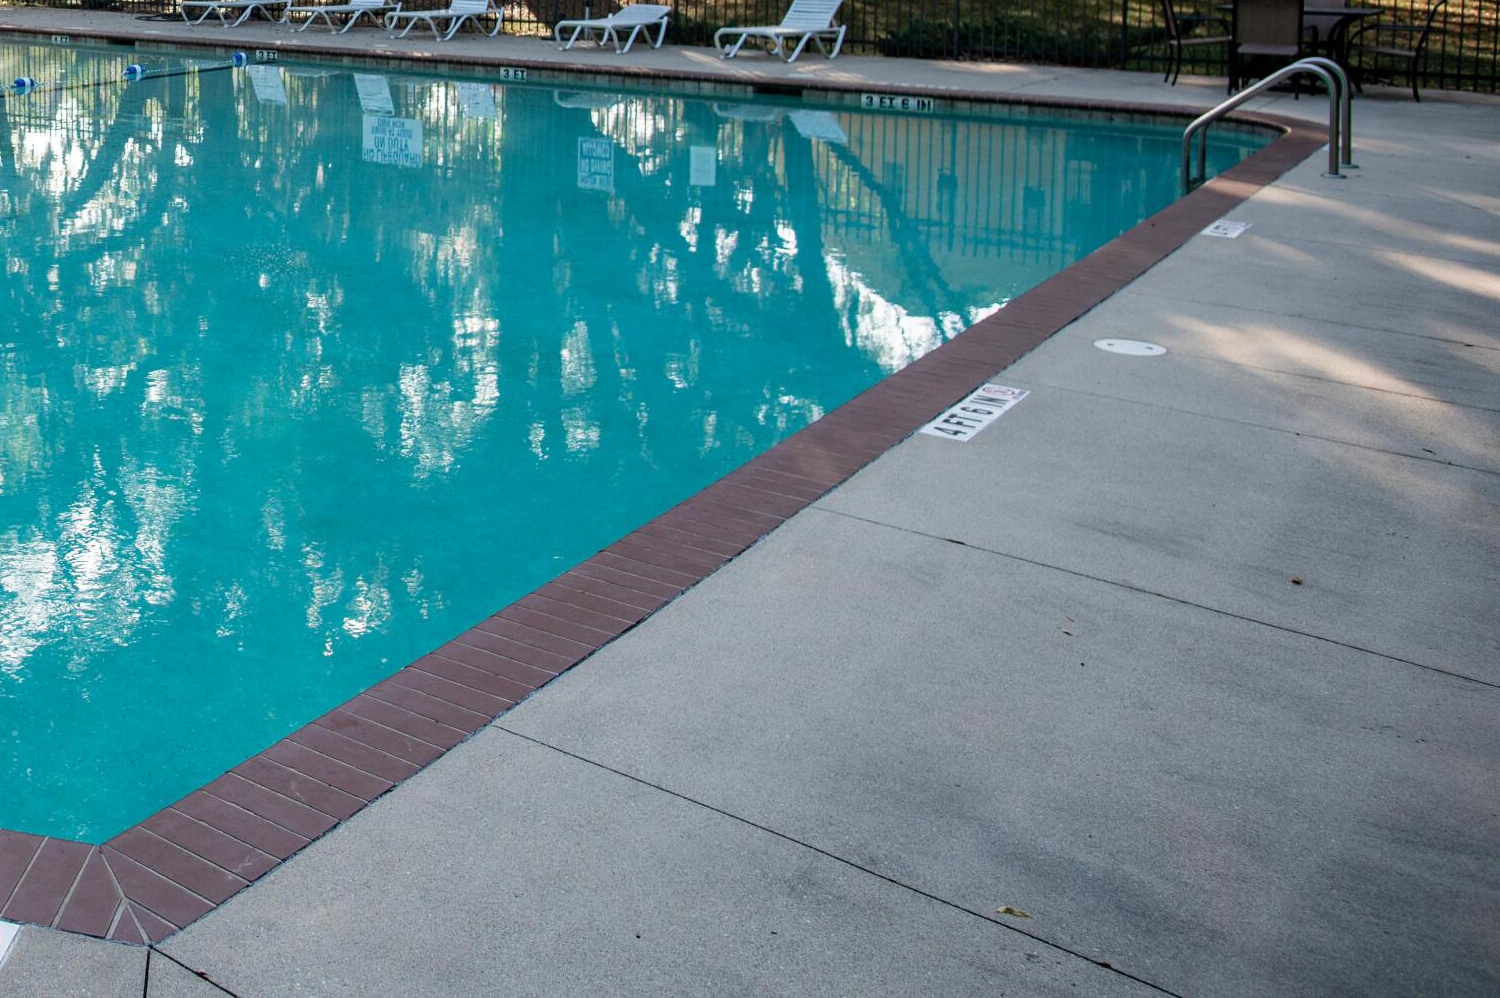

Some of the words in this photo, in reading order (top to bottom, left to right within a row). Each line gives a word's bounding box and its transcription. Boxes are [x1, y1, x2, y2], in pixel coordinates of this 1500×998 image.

[503, 68, 510, 79] 3
[514, 69, 526, 80] FT
[866, 95, 873, 107] 3
[969, 394, 1011, 409] IN
[960, 406, 994, 416] 6
[942, 413, 983, 429] FT
[933, 426, 967, 437] 4
